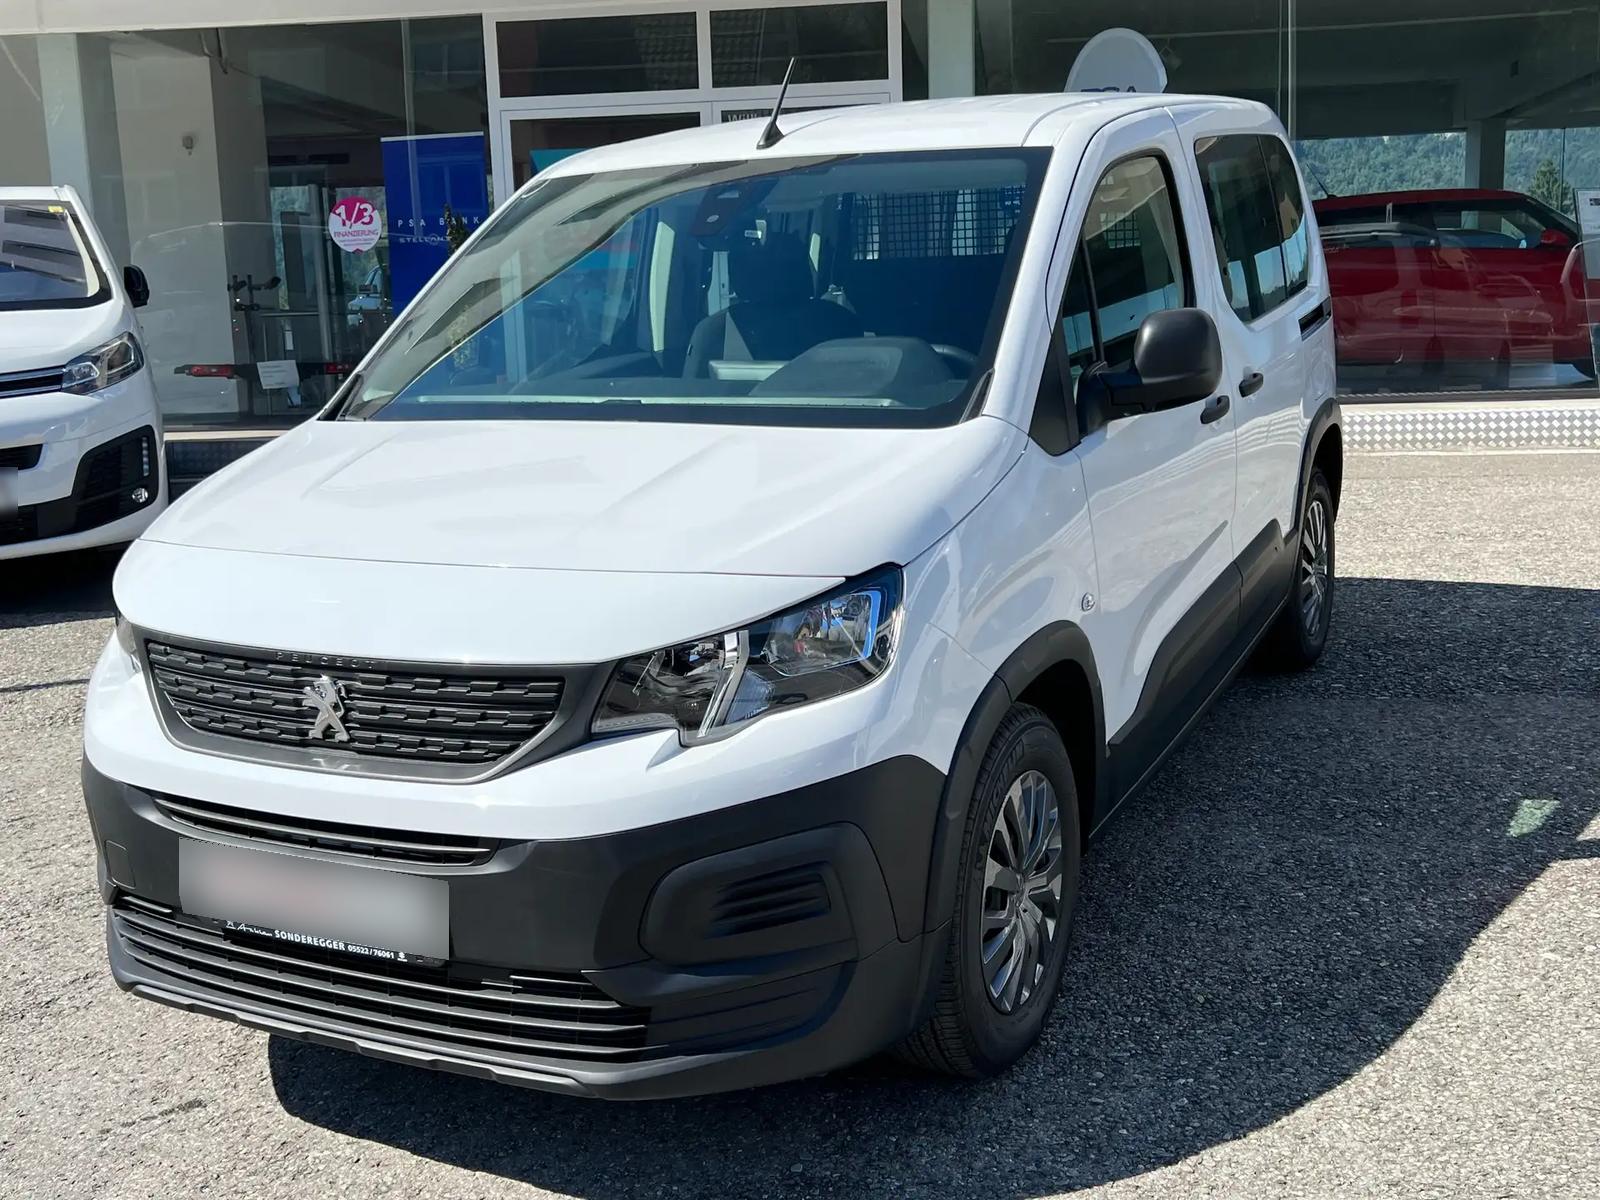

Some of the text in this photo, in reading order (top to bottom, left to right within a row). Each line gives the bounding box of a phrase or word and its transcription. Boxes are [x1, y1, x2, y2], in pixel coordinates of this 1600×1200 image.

[335, 202, 374, 229] 1/3
[398, 217, 480, 228] PSA BANK
[275, 652, 376, 669] PEUGEOT
[274, 929, 346, 951] SONDEREGGER
